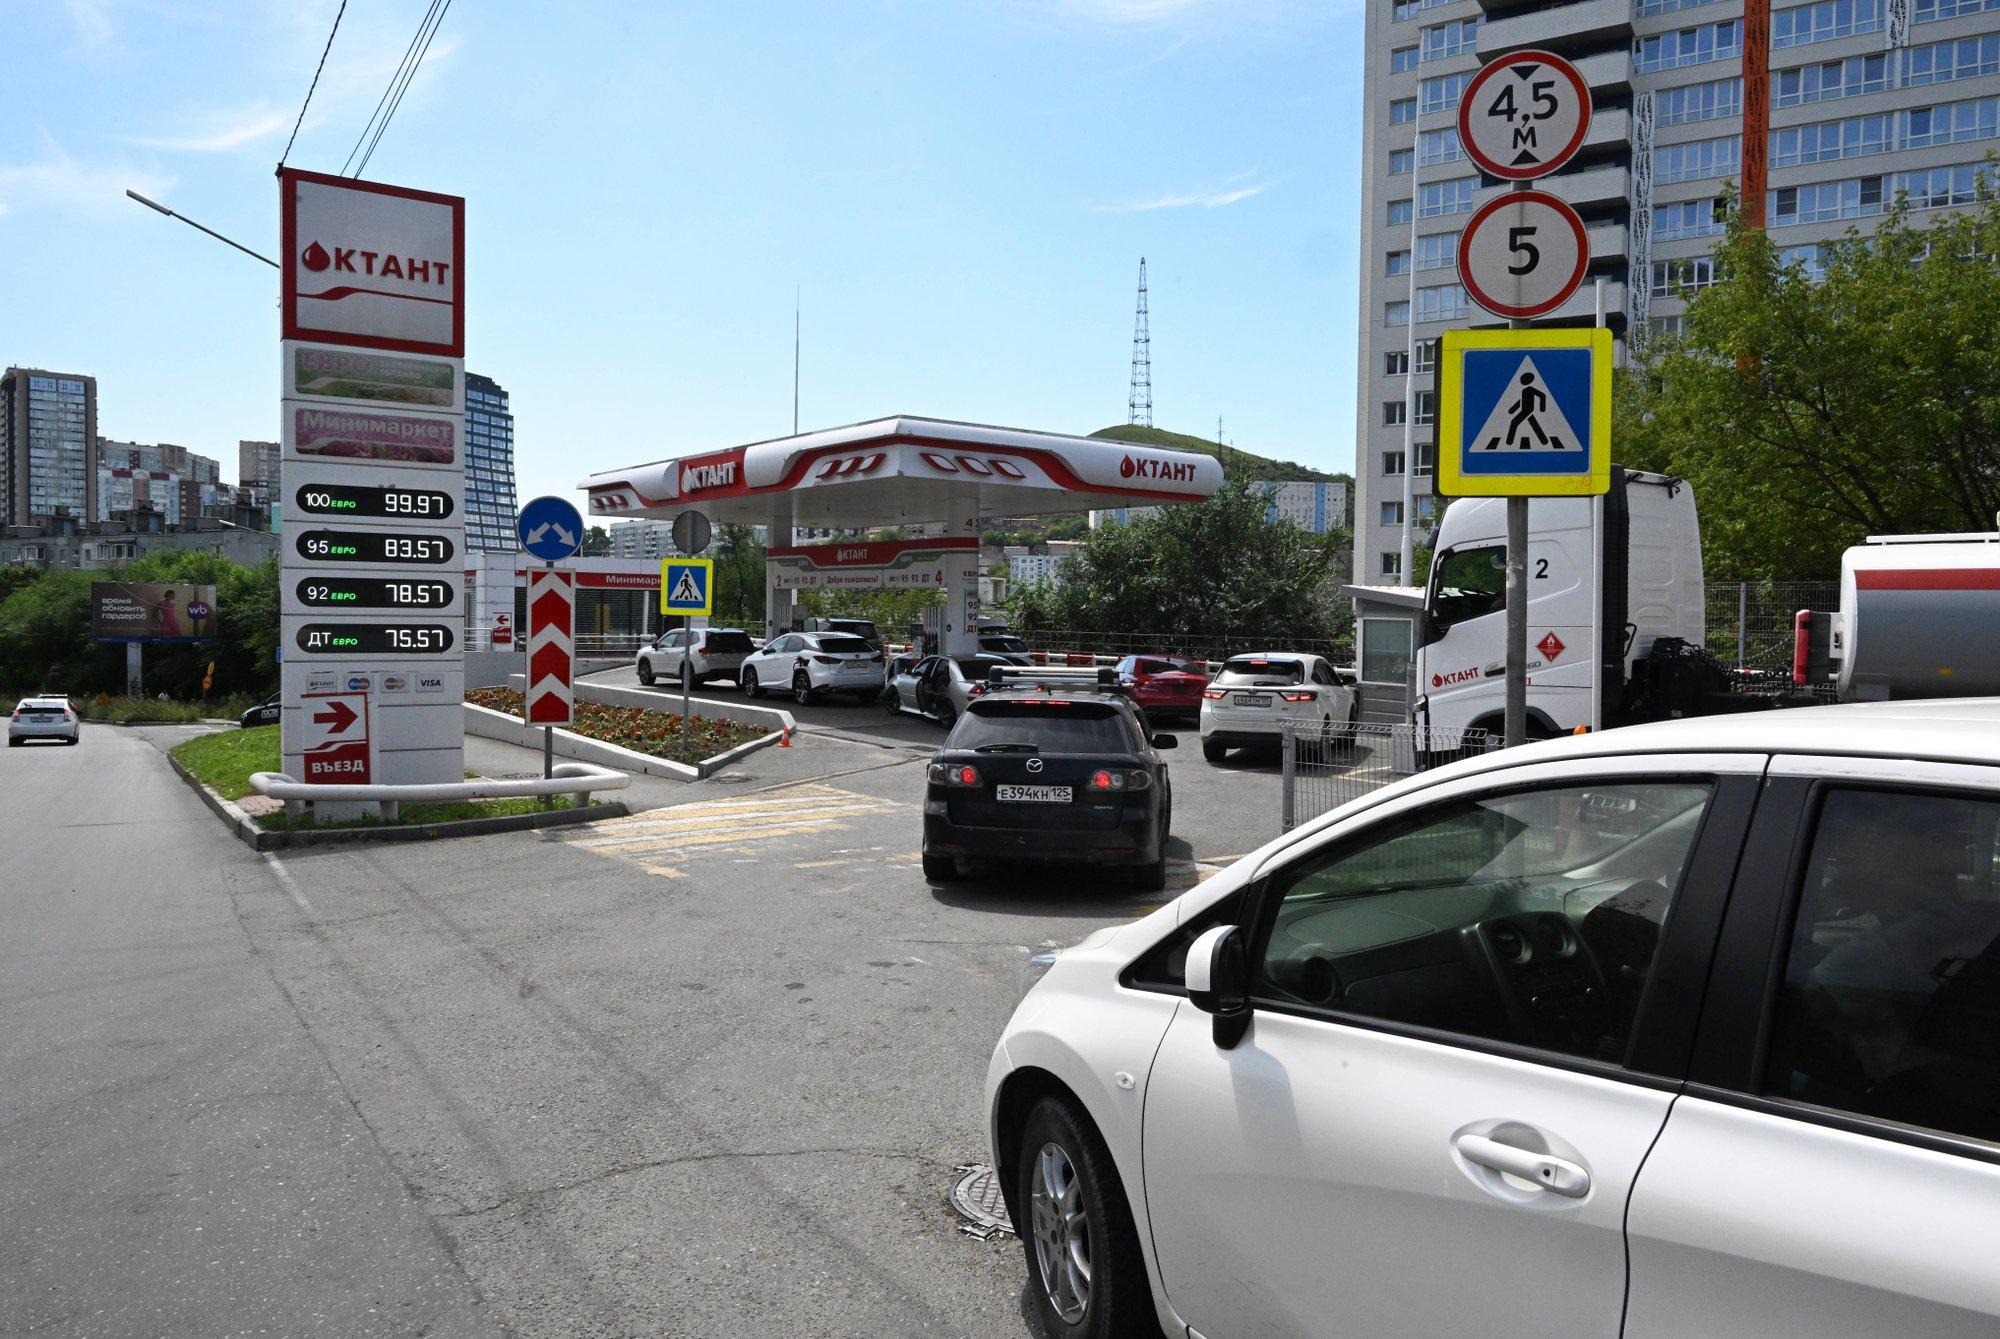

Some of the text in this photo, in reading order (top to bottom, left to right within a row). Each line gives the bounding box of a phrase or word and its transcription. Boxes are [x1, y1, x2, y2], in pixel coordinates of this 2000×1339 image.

[1488, 80, 1558, 128] 4,5
[1508, 226, 1540, 276] 5
[303, 411, 450, 441] Минимаркет
[305, 492, 444, 514] 100 ЕВРО 99.97
[307, 539, 444, 559] 95 ЕВРО 83.57
[935, 570, 942, 585] 4
[1535, 558, 1549, 579] 2
[776, 574, 781, 587] 2
[307, 584, 444, 603] 92 ЕВРО 78.57
[102, 604, 145, 612] обновить
[189, 605, 207, 615] wb
[308, 632, 332, 647] ДТ
[385, 629, 444, 648] 75.57
[421, 679, 441, 687] VISA
[312, 760, 364, 773] ВЪЕЗД
